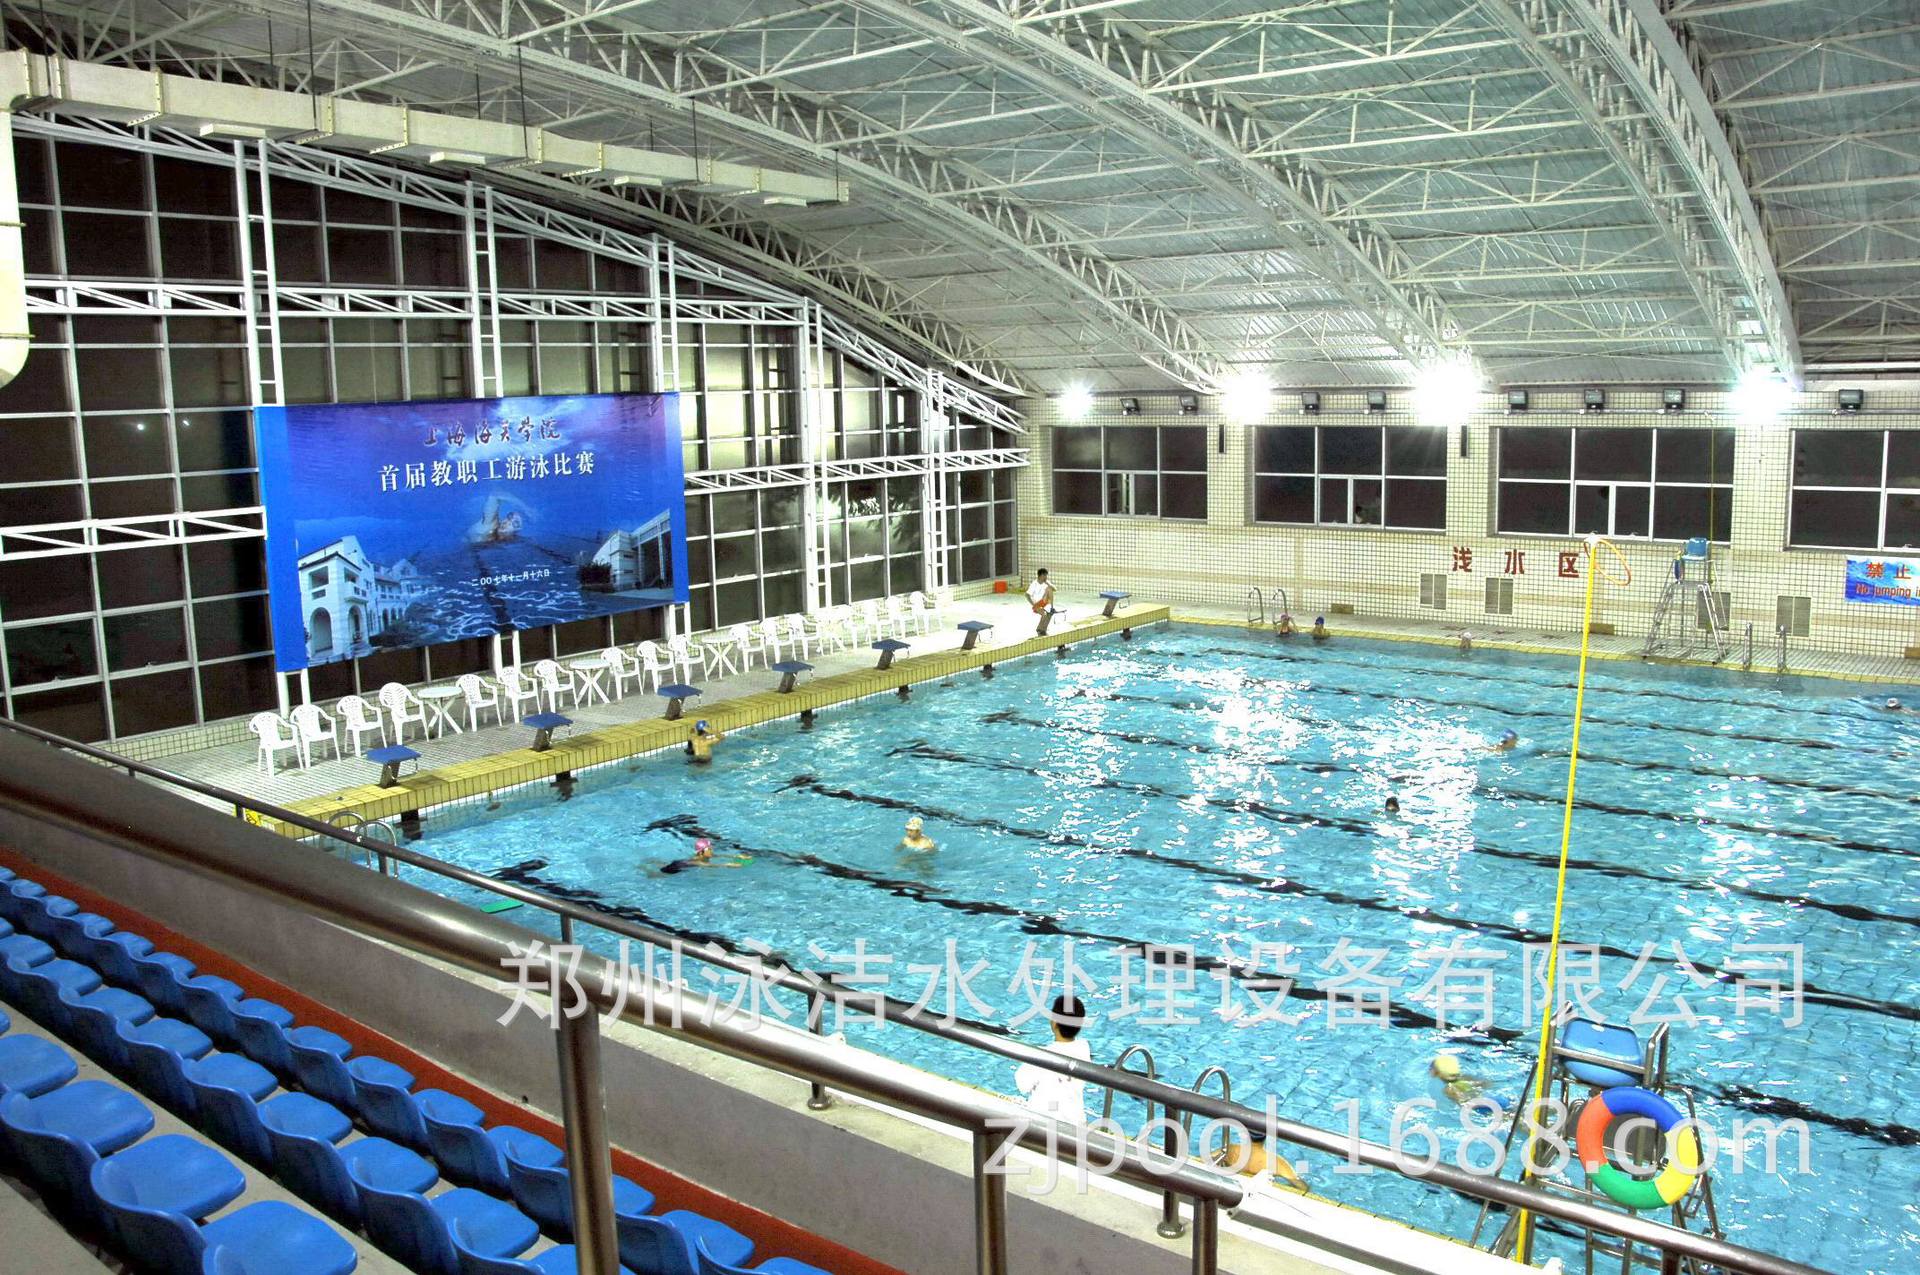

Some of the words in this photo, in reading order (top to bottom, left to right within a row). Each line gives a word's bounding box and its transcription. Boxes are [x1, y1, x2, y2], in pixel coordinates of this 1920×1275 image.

[378, 451, 595, 492] 首届教职工游泳比赛
[1452, 546, 1580, 578] 浅水区
[1866, 561, 1911, 579] 禁止
[1856, 583, 1869, 595] No
[1873, 585, 1912, 599] jumping
